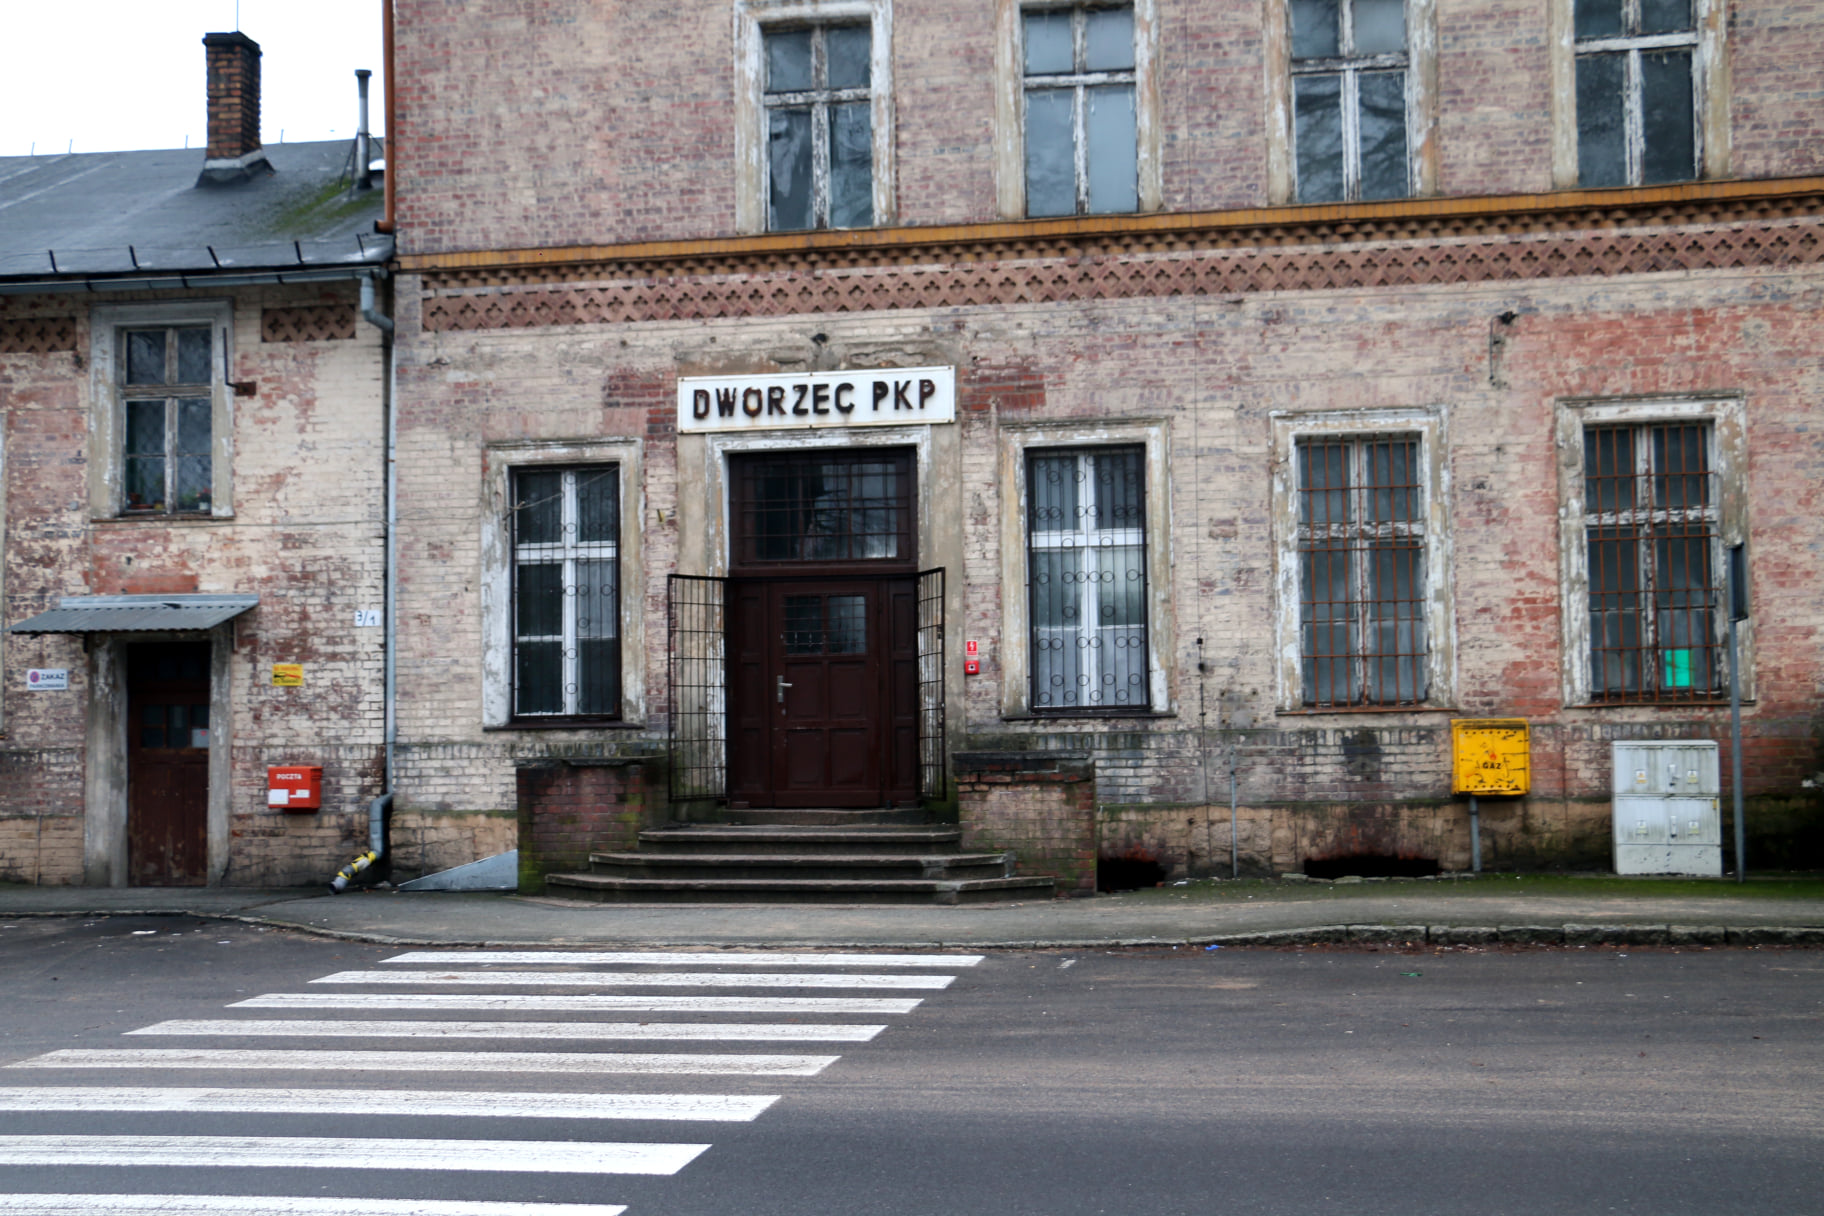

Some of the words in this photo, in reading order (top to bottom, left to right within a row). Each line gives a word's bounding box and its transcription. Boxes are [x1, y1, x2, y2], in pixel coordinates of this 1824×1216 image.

[693, 382, 855, 419] DWORZEC
[872, 379, 936, 411] PKP
[1482, 761, 1502, 771] GAZ
